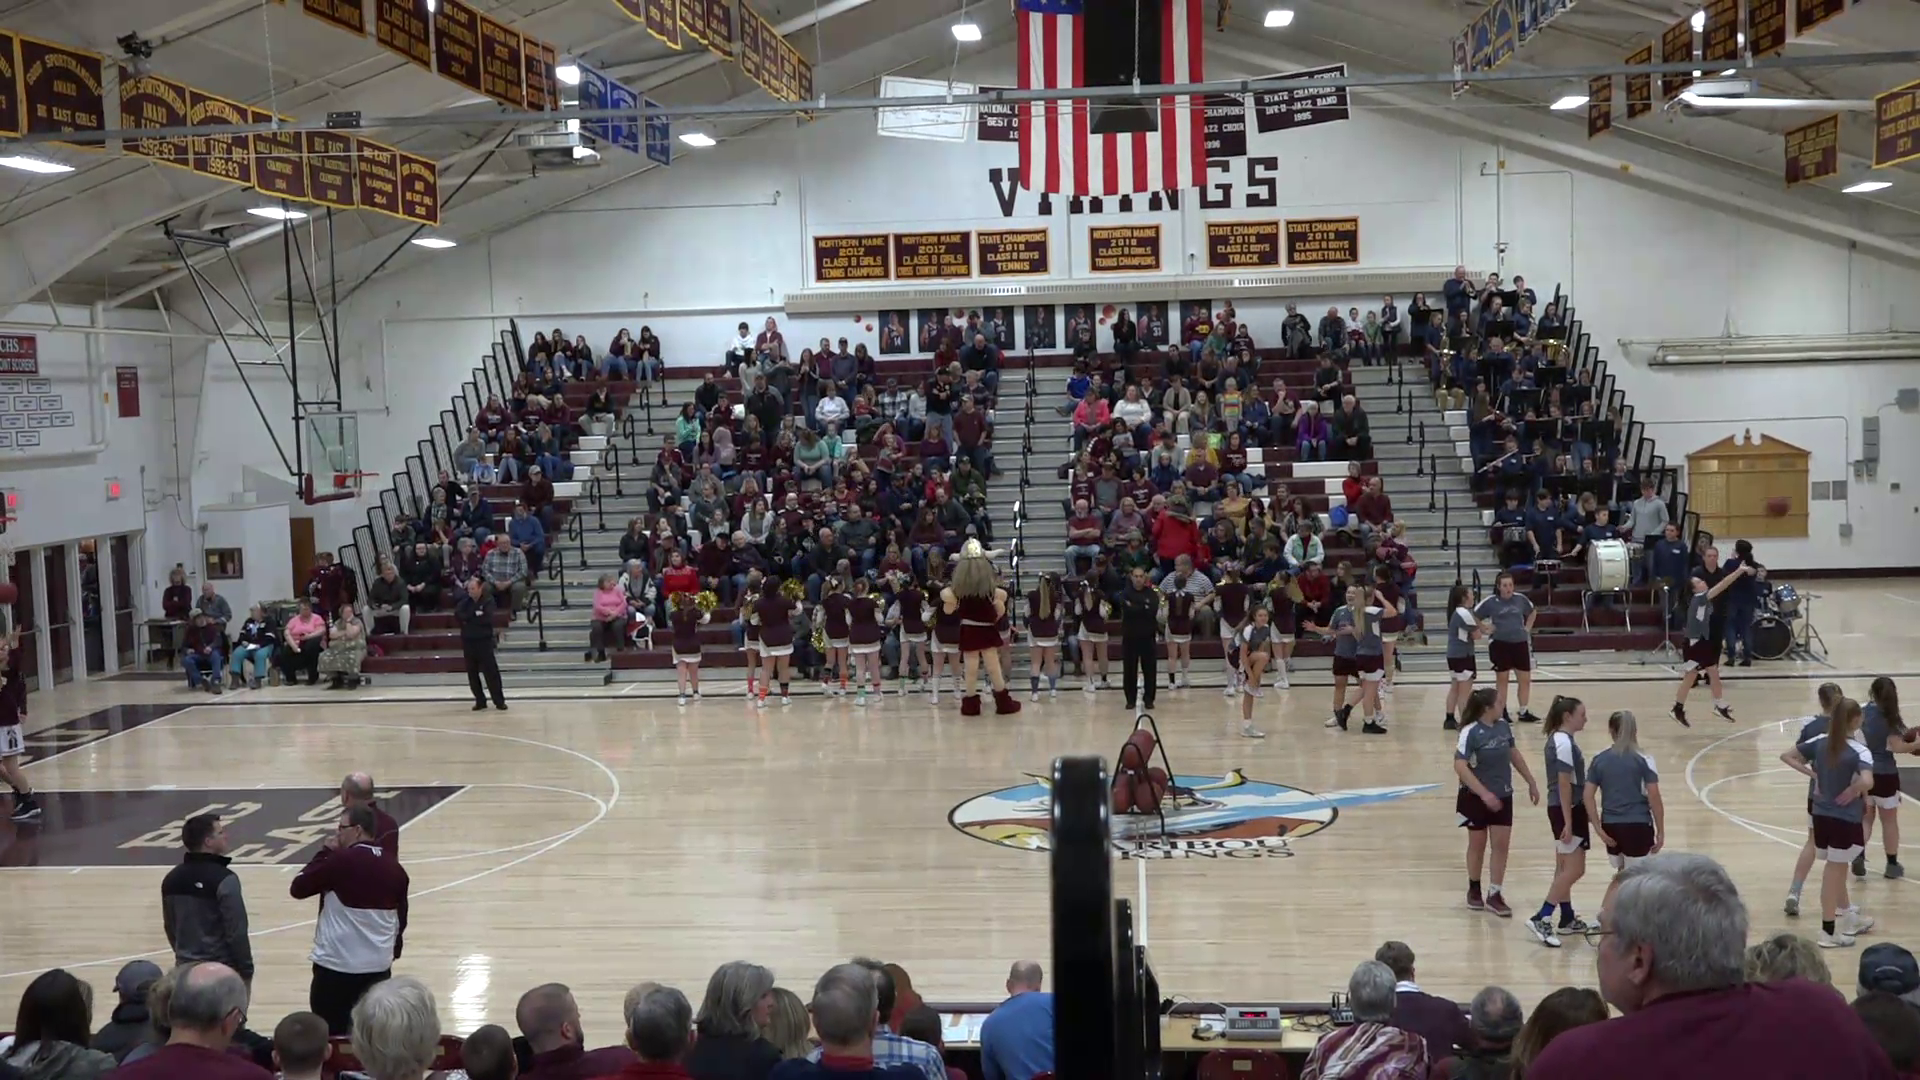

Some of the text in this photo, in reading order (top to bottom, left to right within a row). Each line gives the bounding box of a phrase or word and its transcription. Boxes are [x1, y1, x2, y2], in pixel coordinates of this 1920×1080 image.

[1263, 86, 1337, 104] STATE CHAMPIONS
[1316, 95, 1338, 107] BAND
[979, 103, 1012, 114] NATIONAL
[52, 106, 72, 123] EAST
[75, 111, 97, 127] GIRLS
[1203, 122, 1245, 133] AZZ CHOIR
[208, 157, 240, 178] 1992-93
[1209, 225, 1277, 236] STATE CHAMPIONS
[1288, 222, 1356, 233] STATE CHAMPIONS
[979, 232, 1046, 245] STATE CHAMPIONS
[1092, 228, 1157, 239] NORTHERN MAINE
[818, 237, 885, 248] NORTHERN MAINE
[902, 234, 962, 245] NORTHERN MAINE
[1295, 242, 1320, 250] CLASS
[1328, 240, 1349, 249] BOYS
[839, 247, 865, 256] 2017
[918, 245, 946, 254] 2017
[1098, 247, 1122, 256] CLASS
[1130, 246, 1152, 255] GIRLS
[1217, 244, 1270, 253] CLASS C BOYS
[822, 256, 849, 267] CLASS
[859, 255, 882, 266] GIRLS
[903, 255, 929, 266] CLASS
[940, 254, 964, 264] GIRLS
[987, 253, 1011, 262] CLASS
[1019, 251, 1040, 261] BOYS
[1095, 255, 1156, 267] TENNIS CHAMPIONS
[1228, 253, 1260, 264] TRACK
[1293, 250, 1352, 262] BASKETBALL
[940, 264, 969, 275] CHAMPIONS
[997, 261, 1030, 271] TENNIS
[822, 266, 885, 278] TENNIS CHAMPIONS
[0, 338, 19, 353] CHS
[1112, 838, 1289, 851] RIBOU
[1121, 848, 1296, 860] KINGS
